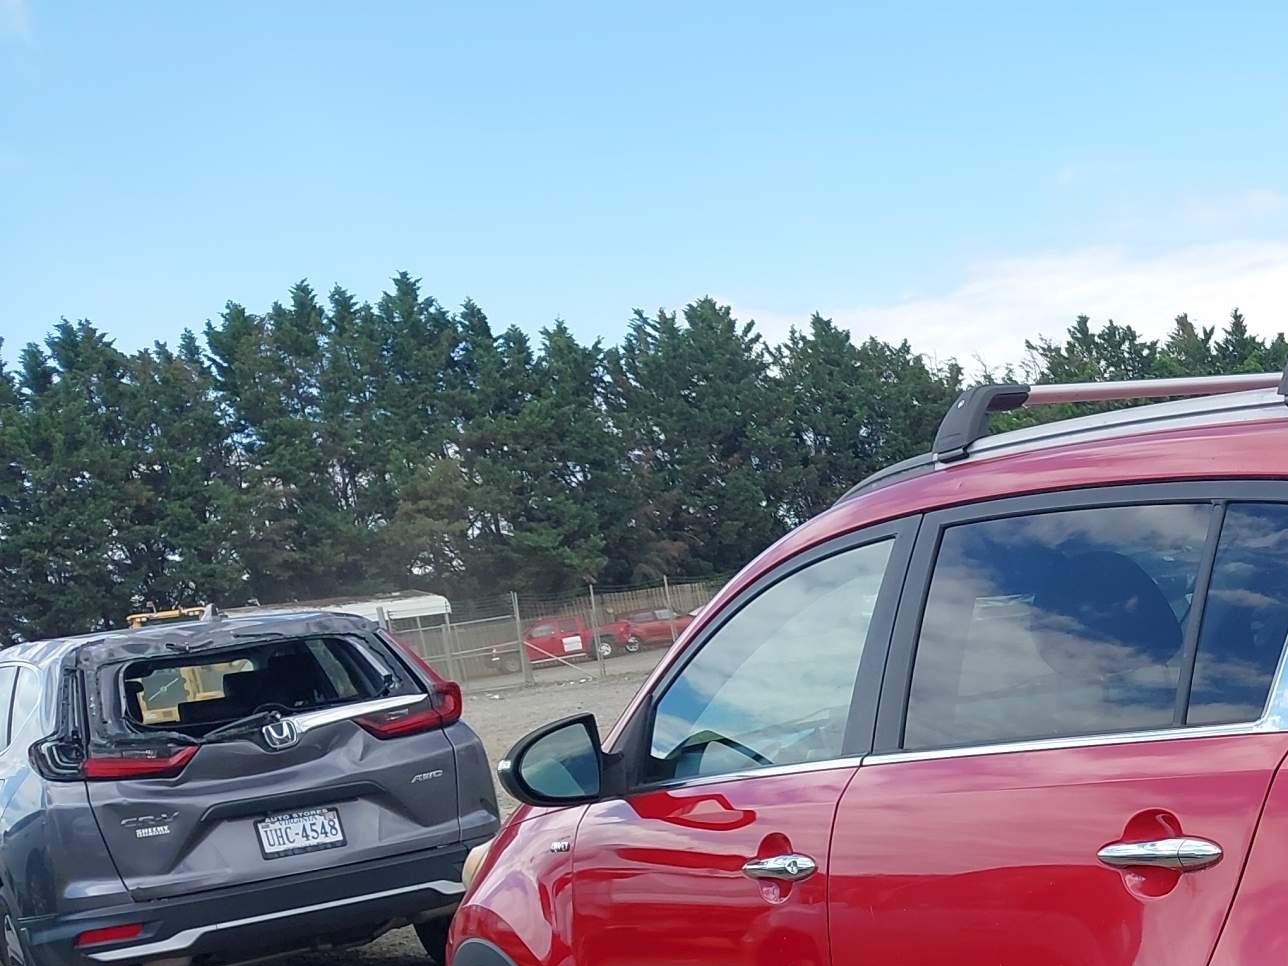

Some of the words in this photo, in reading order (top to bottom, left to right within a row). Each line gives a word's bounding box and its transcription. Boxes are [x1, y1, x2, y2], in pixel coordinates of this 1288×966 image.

[265, 814, 290, 824] AUTO
[292, 808, 329, 819] STORES
[263, 819, 338, 848] UHC-4548
